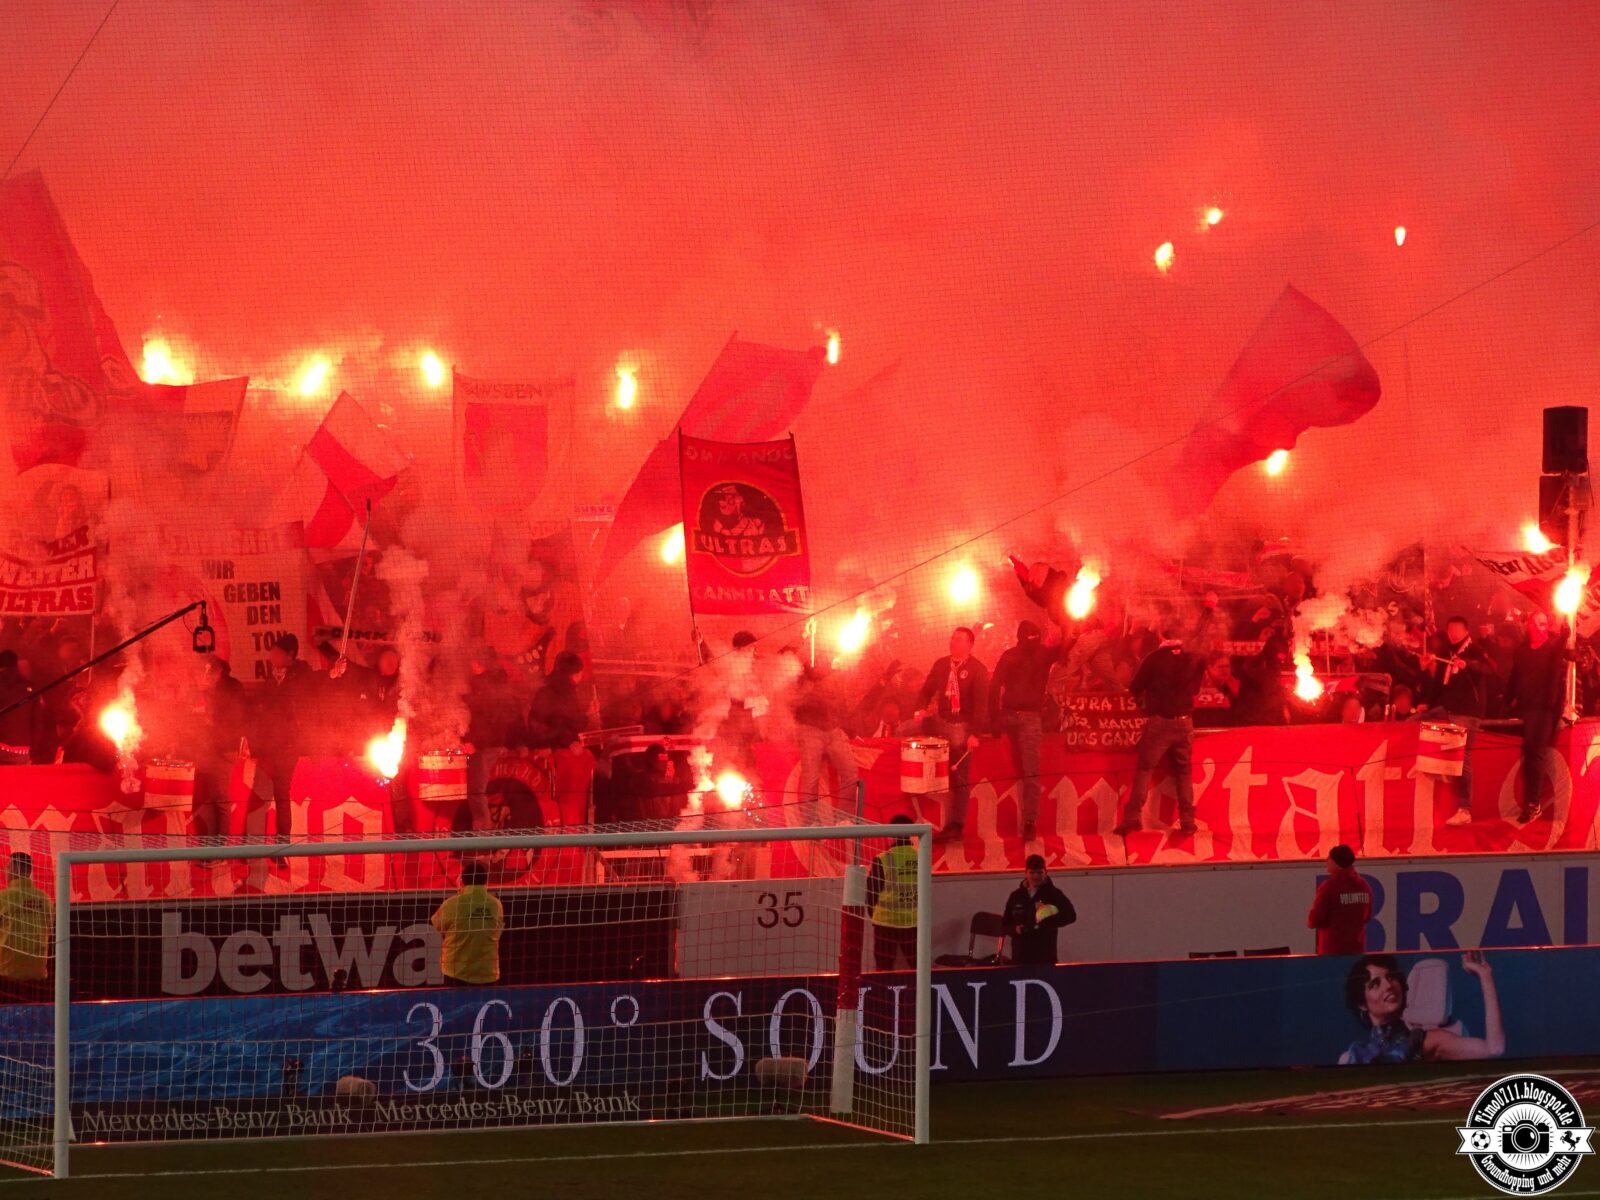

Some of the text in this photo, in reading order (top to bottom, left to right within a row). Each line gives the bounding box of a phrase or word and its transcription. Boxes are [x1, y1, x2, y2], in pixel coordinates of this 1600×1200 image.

[700, 535, 788, 555] ULTRAS
[223, 581, 281, 603] GEBEN
[246, 604, 281, 626] DEN
[756, 891, 805, 928] 35
[402, 979, 1064, 1094] 360° SOUND
[80, 1090, 641, 1133] Mercedes-Benz Bank Mercedes-Benz Bank
